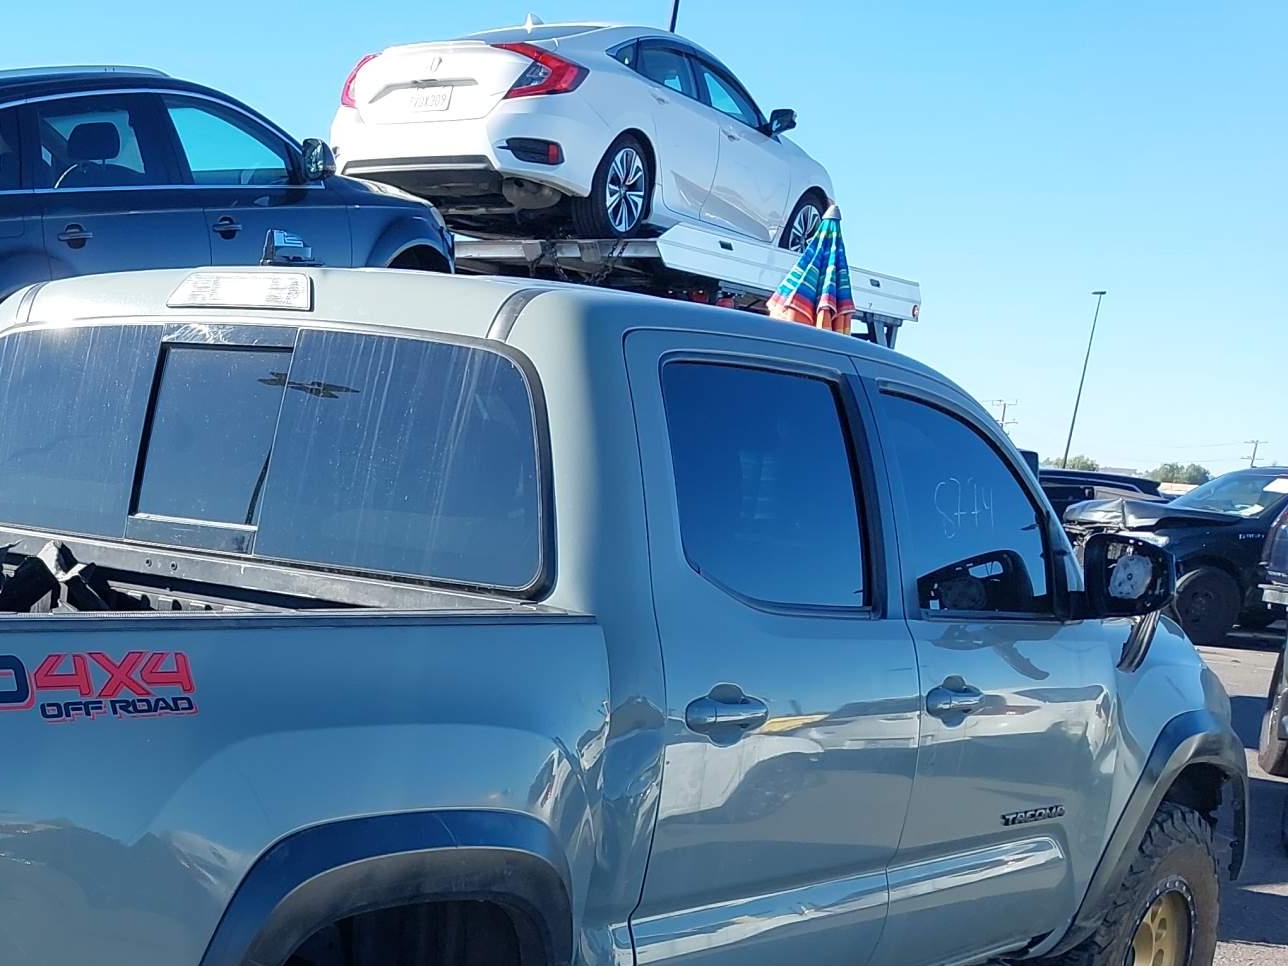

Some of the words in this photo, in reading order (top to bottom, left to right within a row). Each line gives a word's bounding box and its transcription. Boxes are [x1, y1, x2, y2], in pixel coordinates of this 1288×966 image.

[34, 651, 195, 698] 4X4
[39, 699, 106, 723] OFF
[110, 695, 199, 720] ROAD
[1001, 804, 1065, 826] TACOMA
